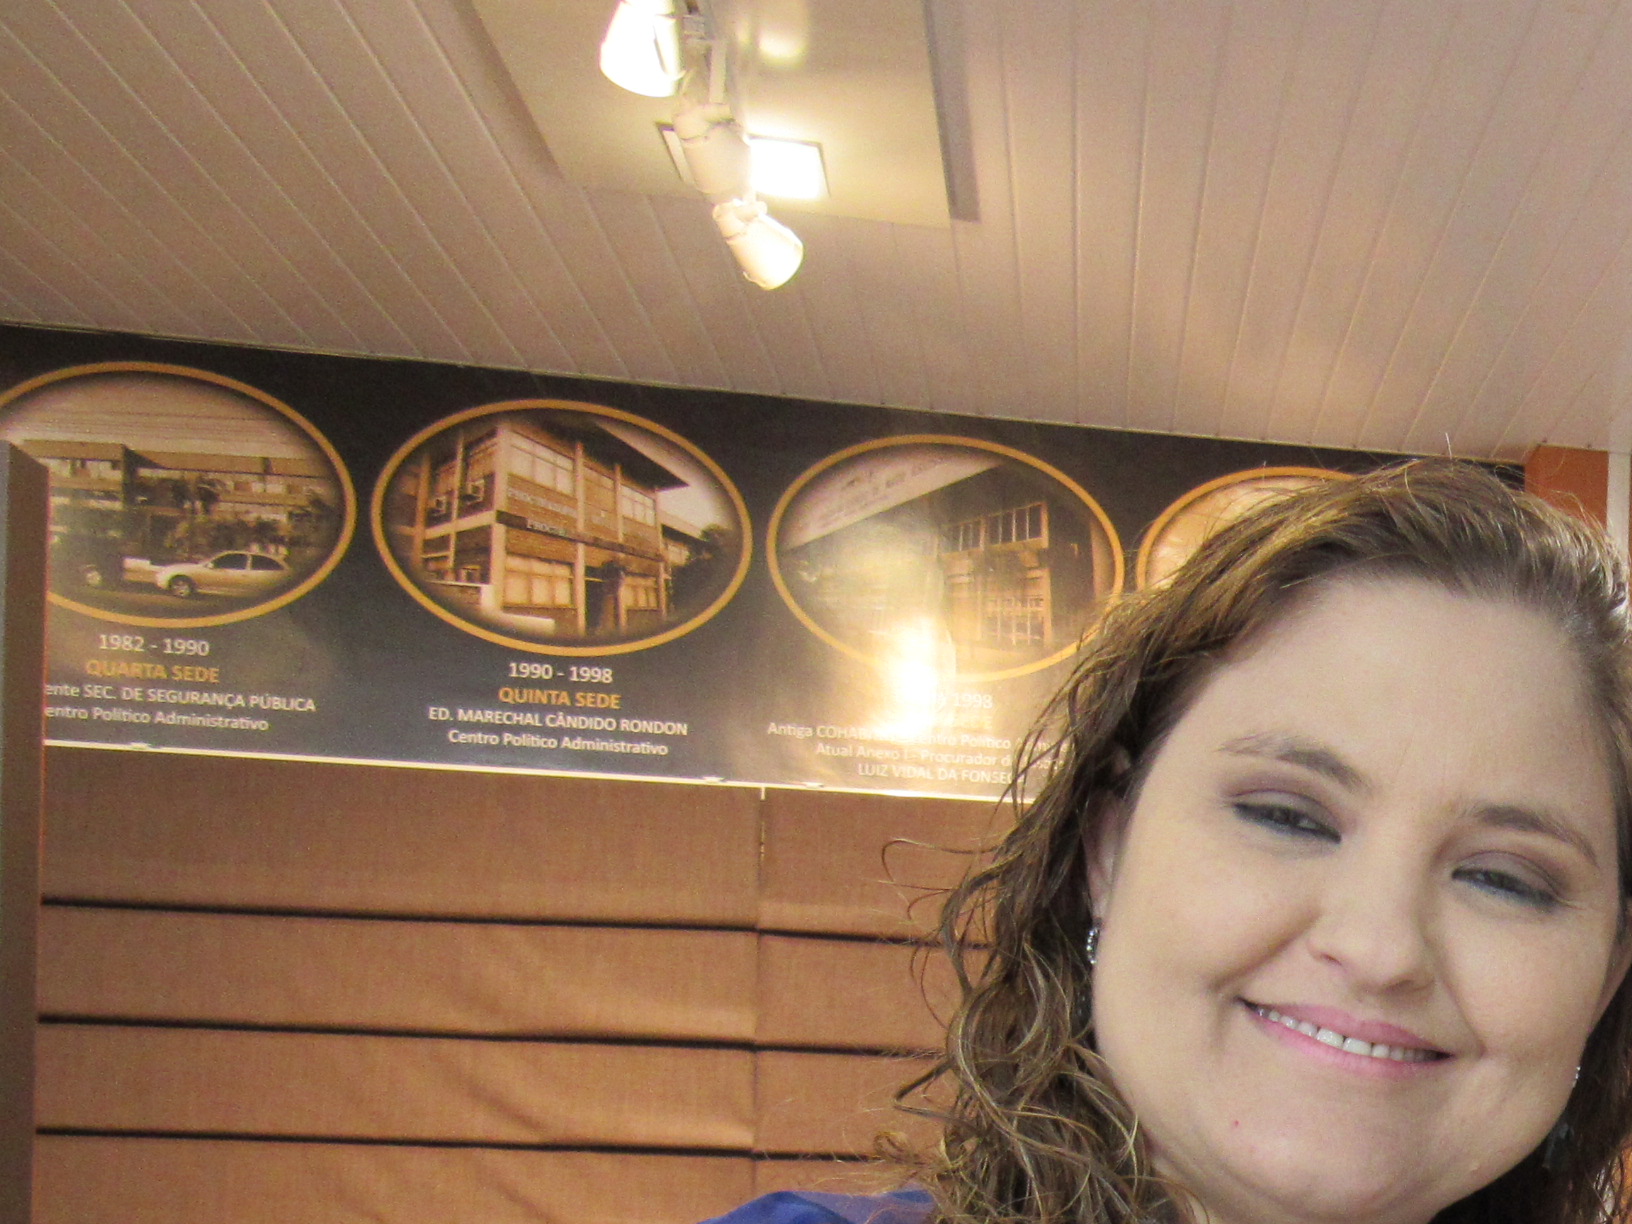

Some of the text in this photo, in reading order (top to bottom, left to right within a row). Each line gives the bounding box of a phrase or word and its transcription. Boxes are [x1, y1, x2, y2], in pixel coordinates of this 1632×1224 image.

[99, 634, 145, 652] 1982
[163, 638, 210, 657] 1990
[86, 659, 221, 683] QUARTA SEDE
[508, 662, 553, 680] 1990
[570, 666, 614, 684] 1998
[45, 683, 317, 712] ente SEC. DE SEGURANÇA PÚBLICA
[499, 687, 622, 710] QUINTA SEDE
[45, 706, 89, 720] entro
[154, 711, 270, 731] Administrativo
[428, 706, 689, 736] ED. MARECHAL CÂNDIDO RONDON
[767, 722, 813, 739] Antiga
[448, 730, 499, 745] Centro
[560, 736, 669, 756] Administrativo
[815, 743, 852, 758] Atual
[921, 749, 997, 768] Procurador
[858, 764, 888, 778] LUIZ
[892, 766, 934, 780] VIDAL
[938, 767, 957, 781] DA
